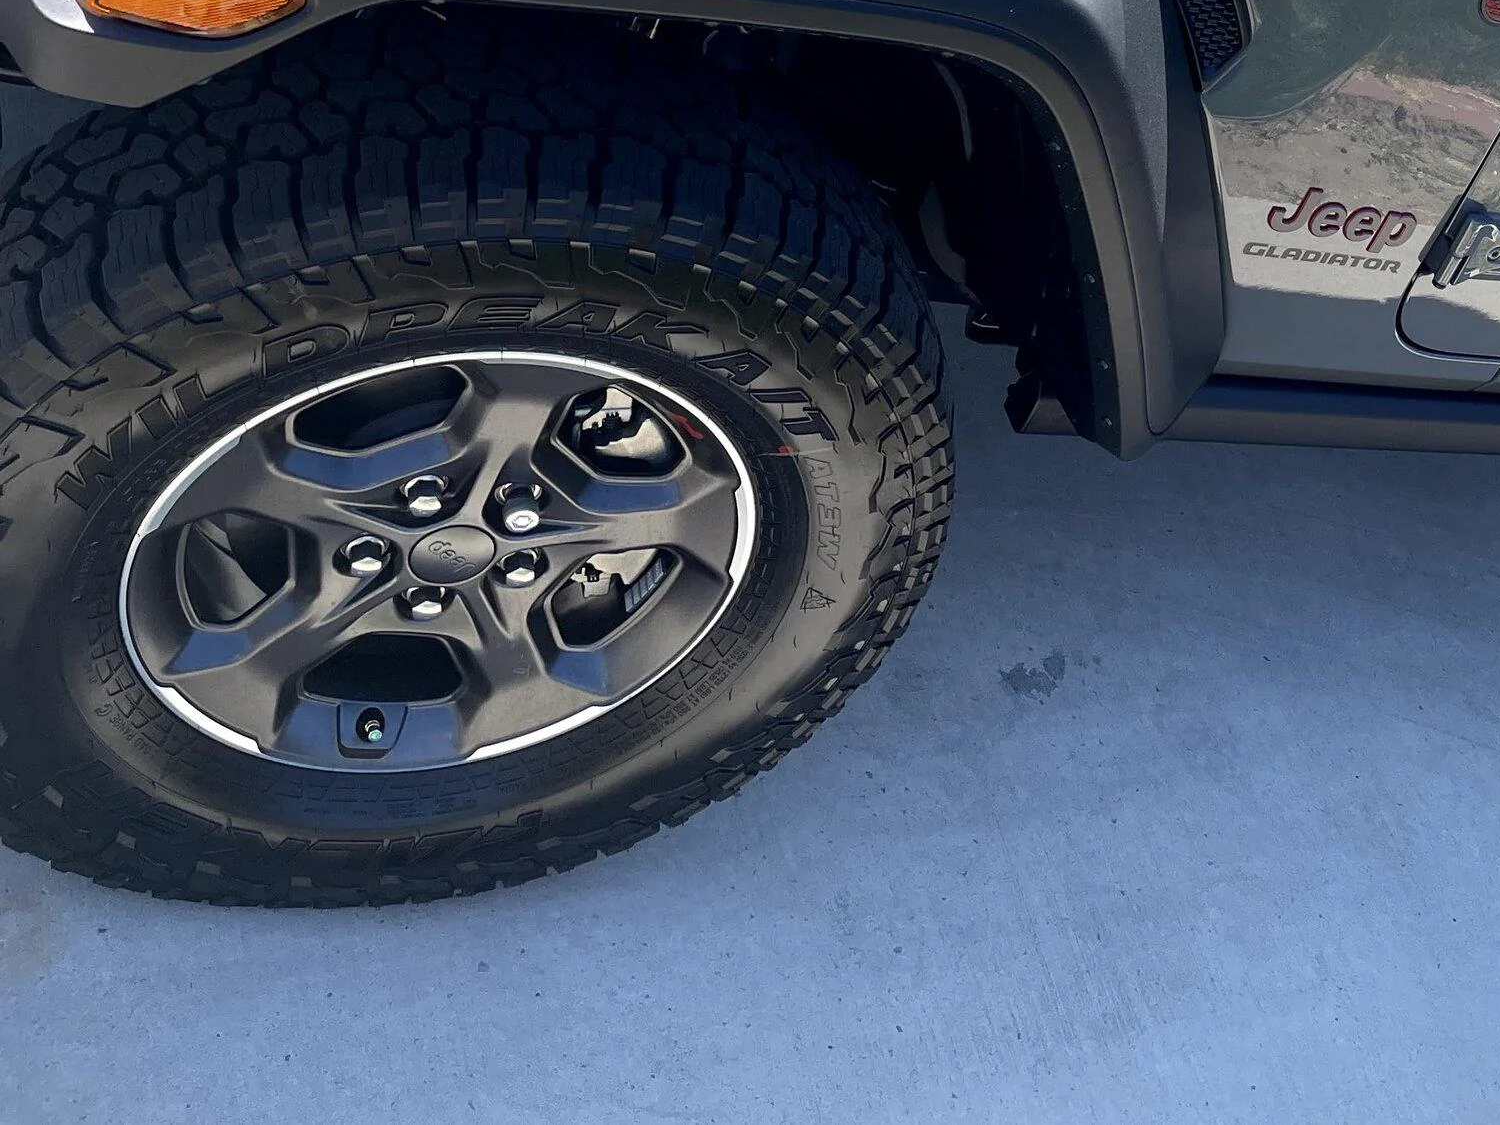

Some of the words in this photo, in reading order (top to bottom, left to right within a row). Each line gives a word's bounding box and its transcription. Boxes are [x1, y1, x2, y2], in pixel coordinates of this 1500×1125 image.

[1267, 187, 1417, 252] Jeep
[1242, 242, 1401, 274] GLADIATOR
[428, 540, 476, 574] Jeep
